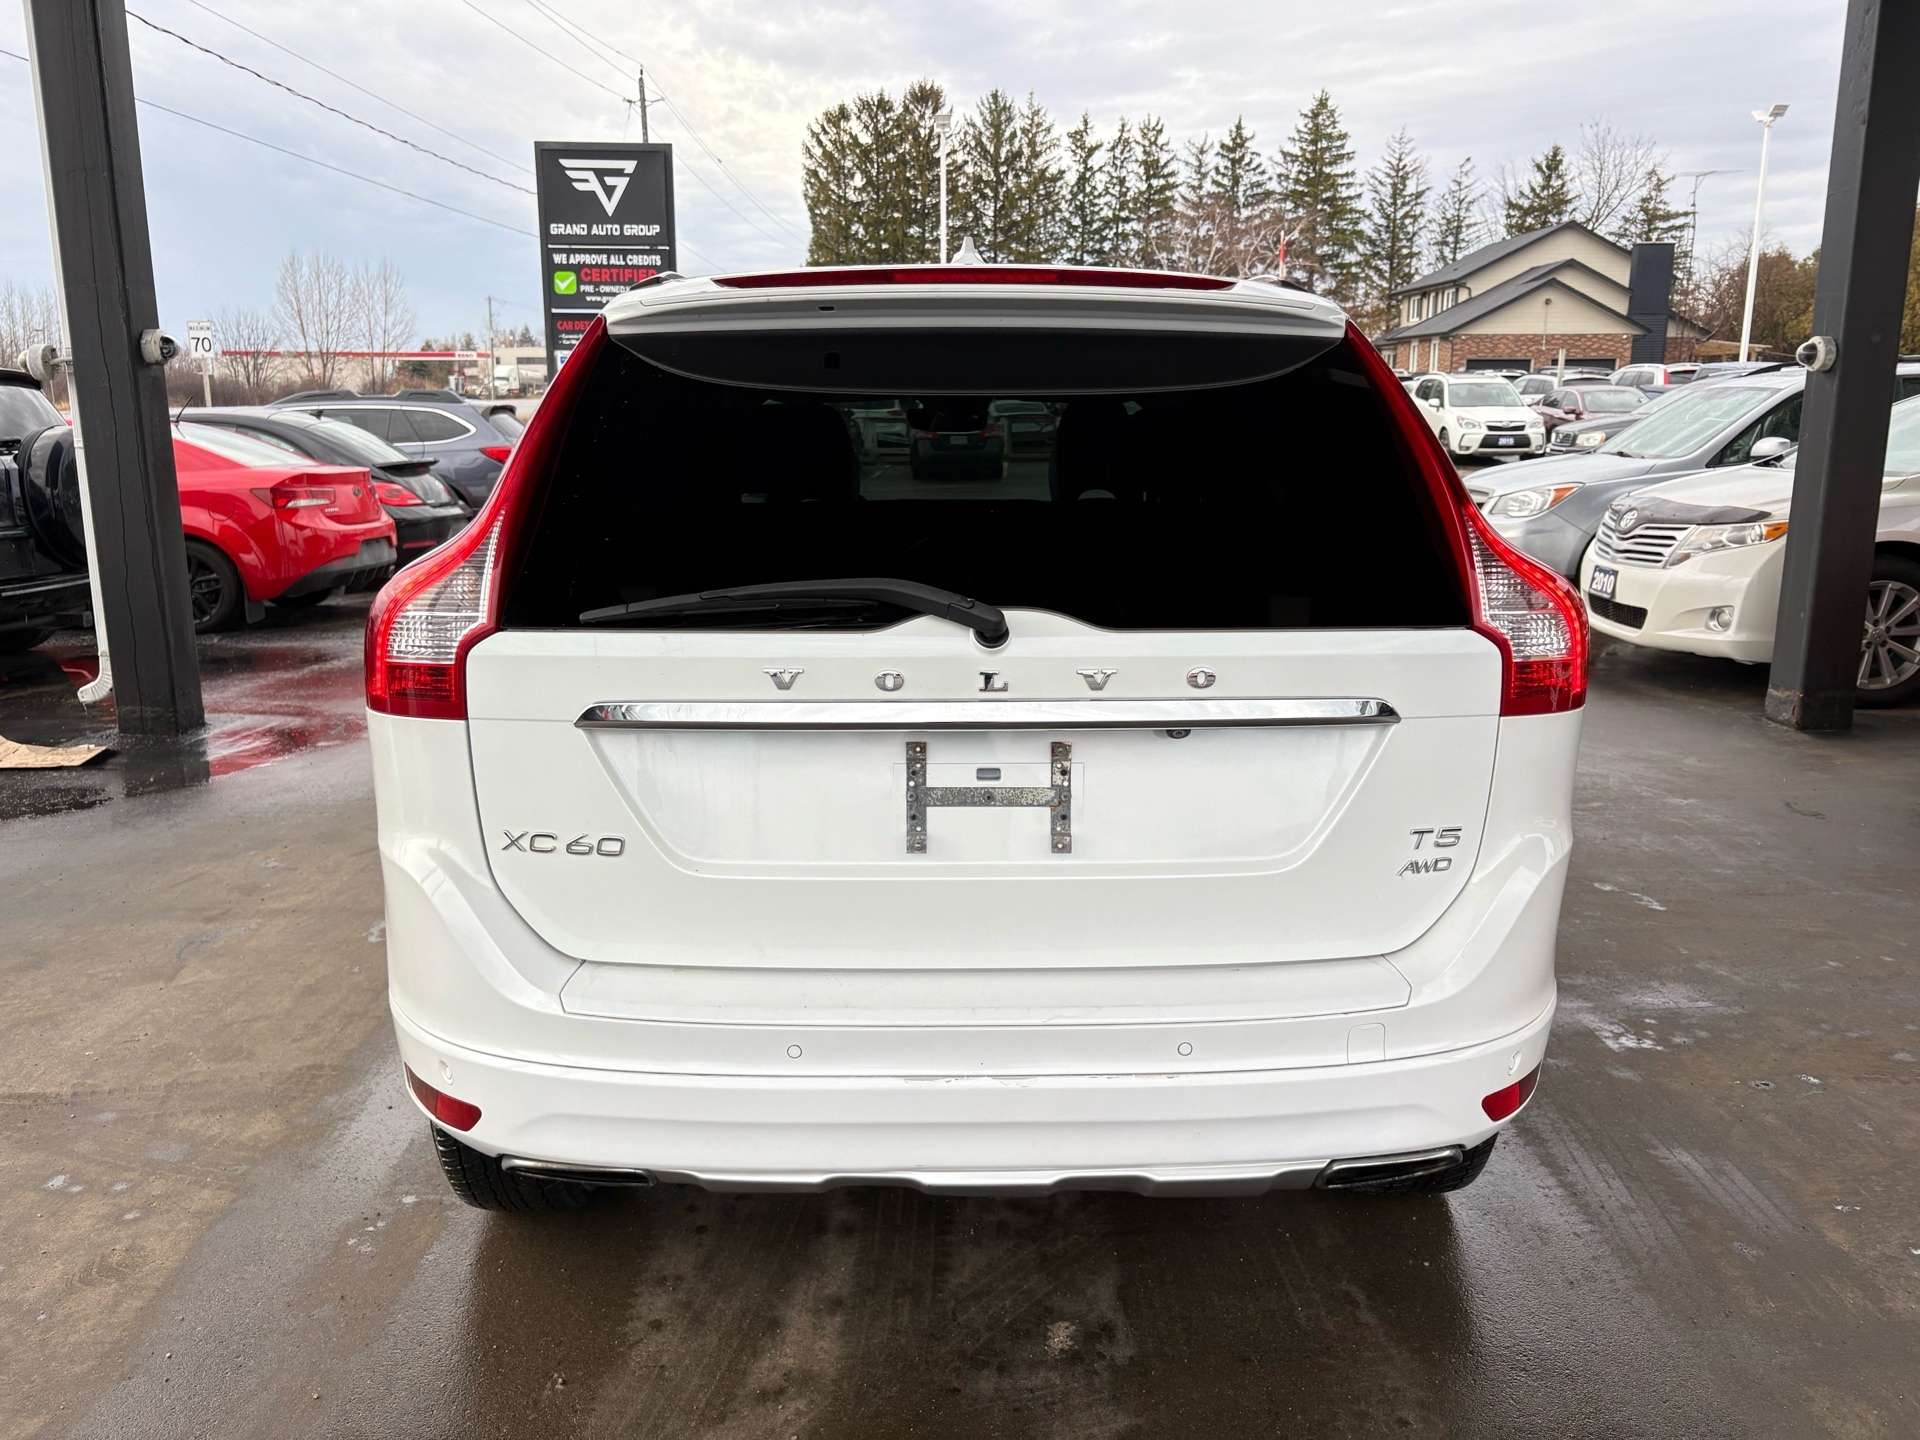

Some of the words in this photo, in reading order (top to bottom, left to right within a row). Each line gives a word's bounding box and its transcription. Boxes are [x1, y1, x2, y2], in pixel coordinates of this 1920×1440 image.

[550, 223, 588, 236] GRAND
[591, 223, 621, 236] AUTO
[623, 224, 661, 237] GROUP
[552, 253, 568, 265] WE
[569, 253, 608, 265] APPROVE
[609, 254, 625, 265] ALL
[626, 254, 662, 266] CREDITS
[580, 285, 595, 293] PRE
[557, 320, 573, 330] CAR
[191, 337, 212, 352] 70
[1591, 571, 1616, 593] 2010
[762, 667, 1217, 692] VOLVO
[1410, 826, 1463, 850] T5
[1397, 857, 1453, 876] AWD
